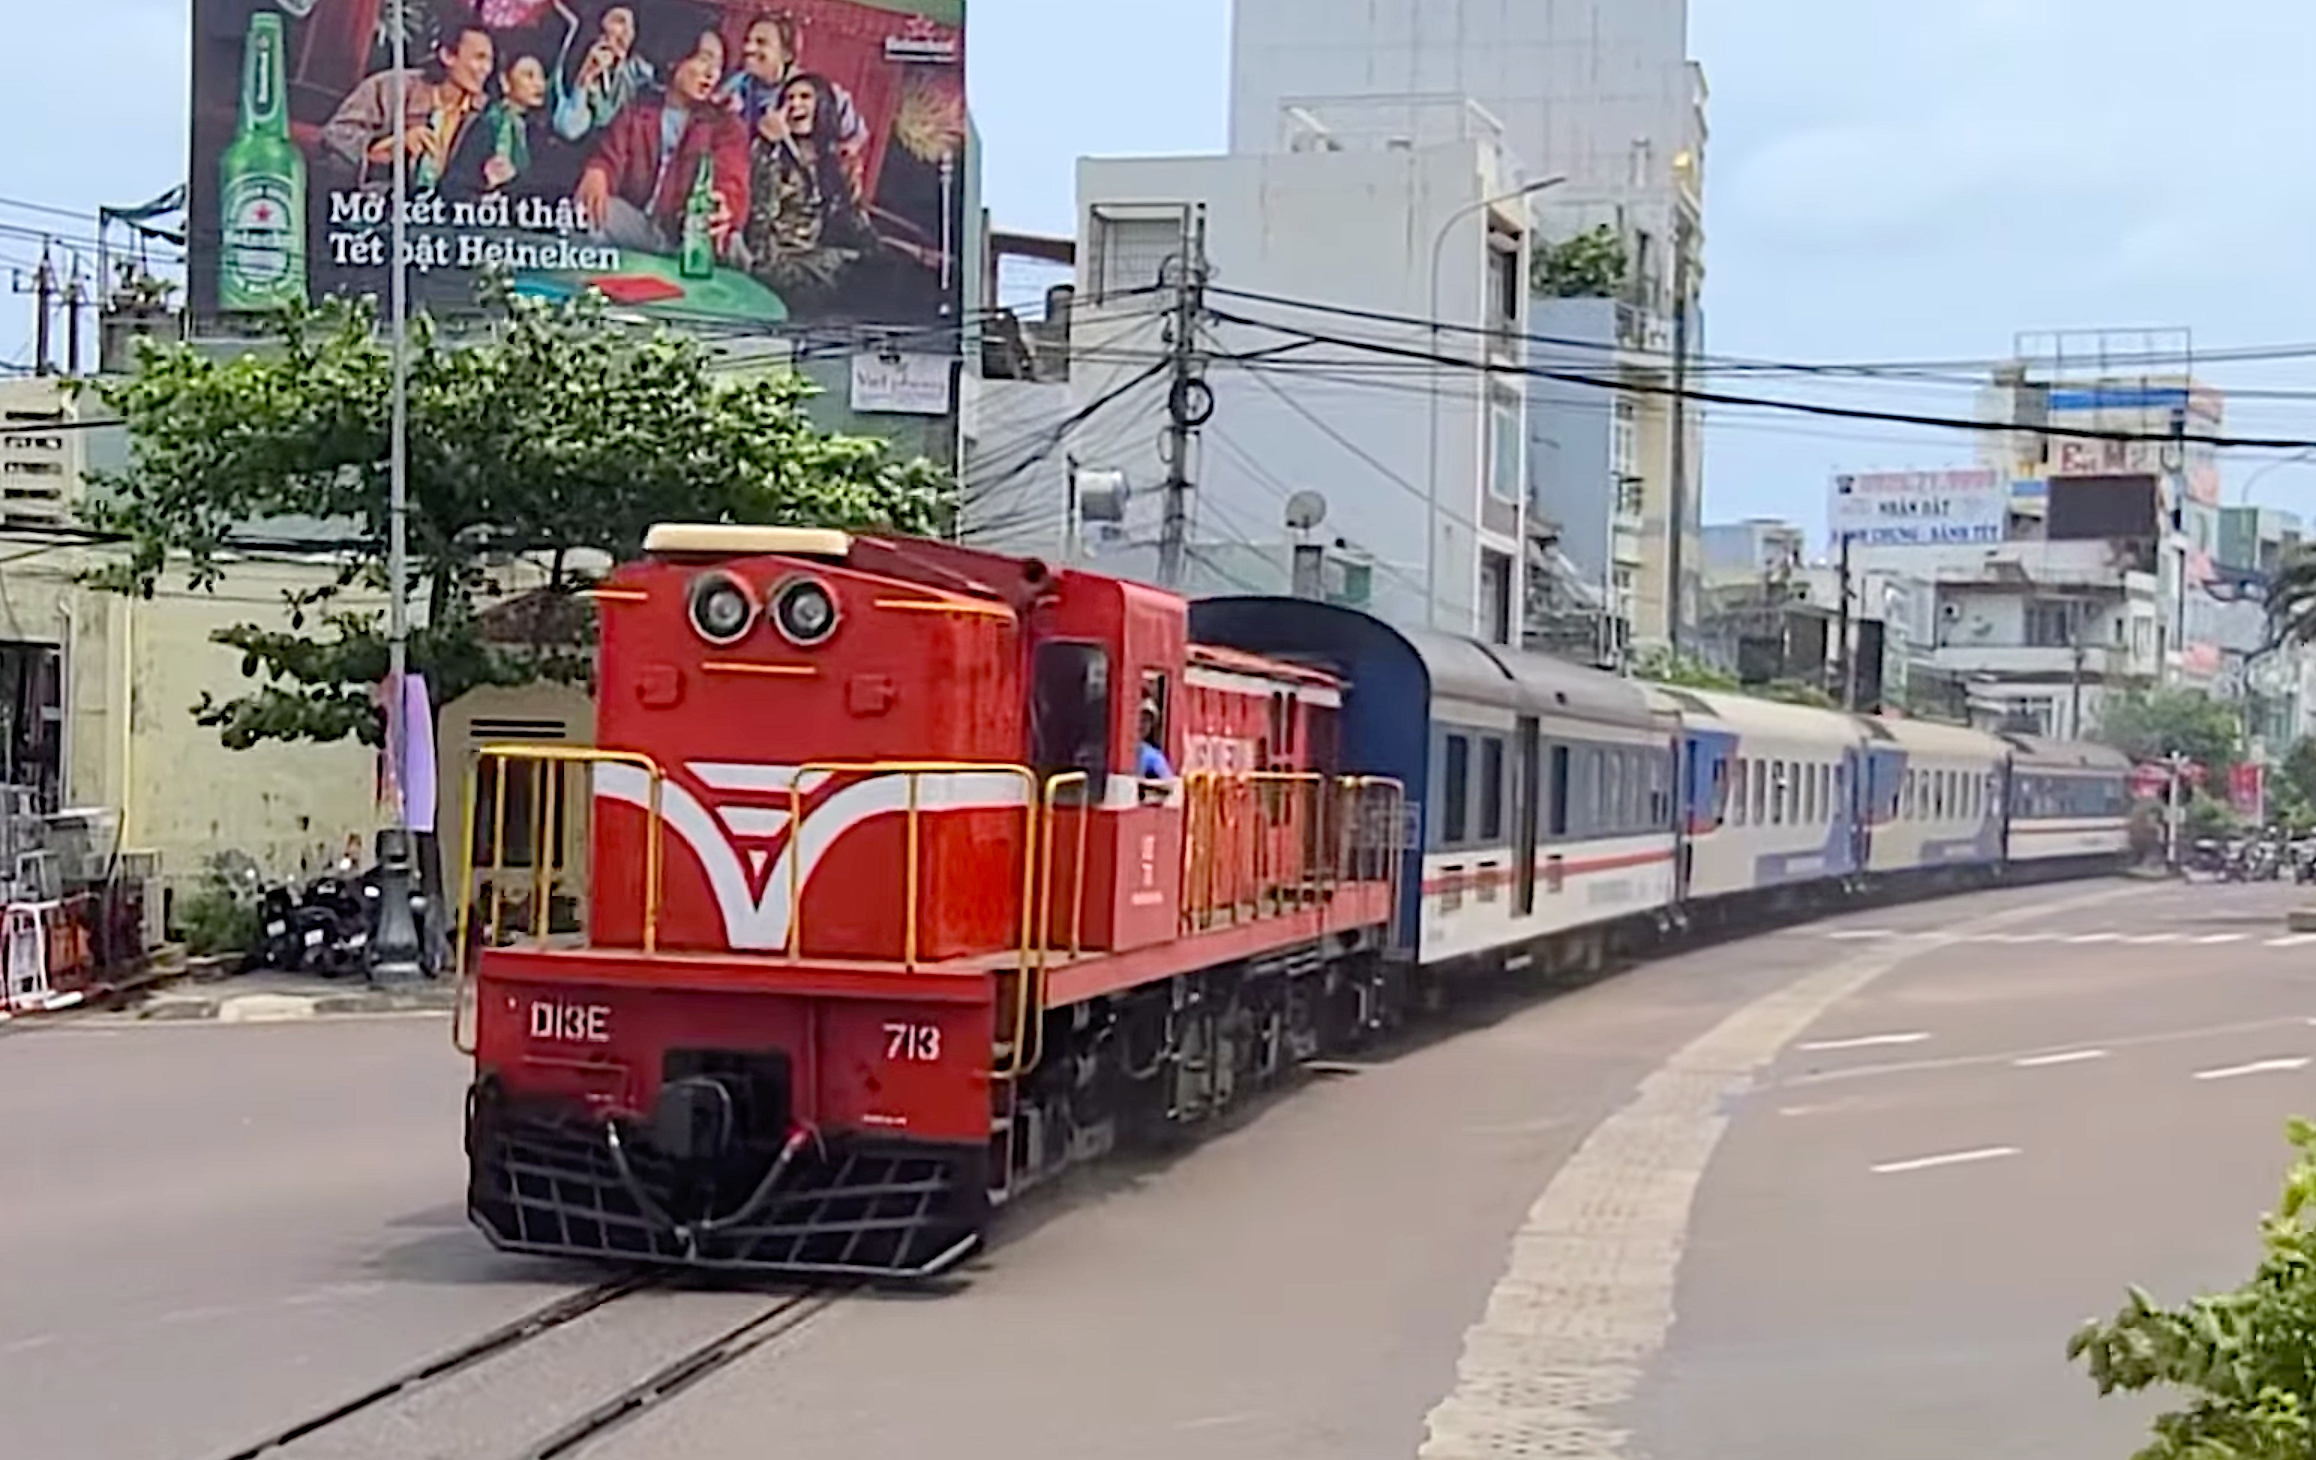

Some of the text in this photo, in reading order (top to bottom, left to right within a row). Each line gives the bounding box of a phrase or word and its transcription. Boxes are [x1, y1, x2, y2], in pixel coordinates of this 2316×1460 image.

[452, 190, 510, 228] nối
[516, 196, 590, 237] thật
[328, 227, 385, 266] Tết
[457, 235, 621, 272] Heineken
[530, 1000, 612, 1043] D13E
[882, 1022, 941, 1061] 713
